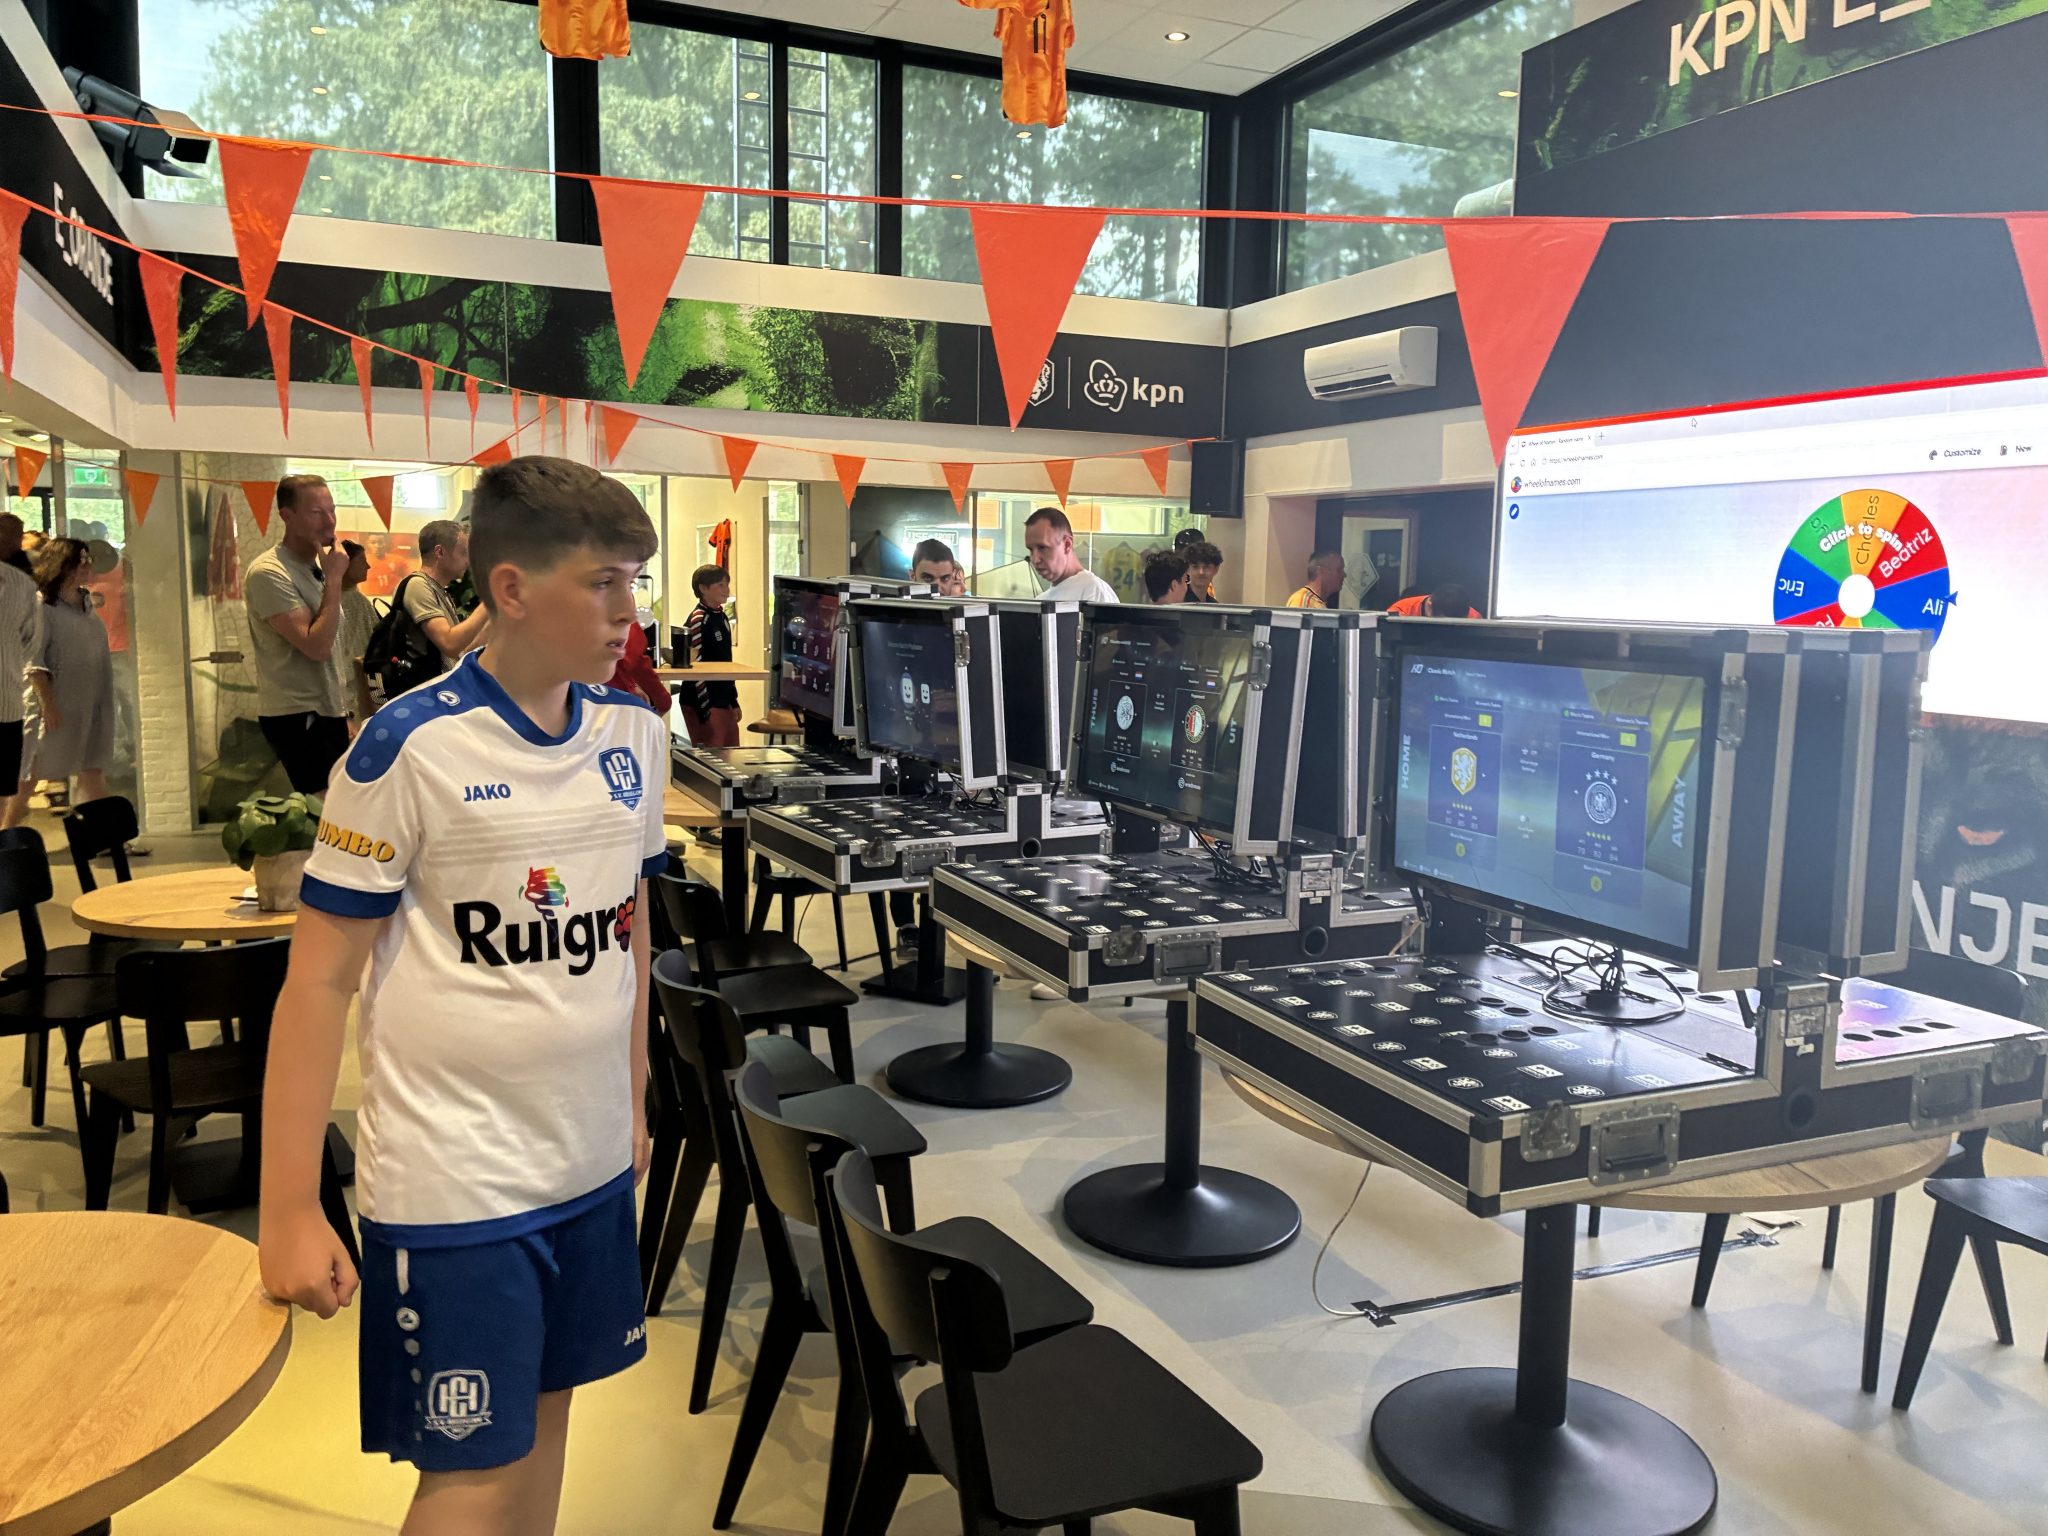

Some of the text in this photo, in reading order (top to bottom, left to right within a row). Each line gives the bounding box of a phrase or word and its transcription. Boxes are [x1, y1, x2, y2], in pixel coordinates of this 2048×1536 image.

[1669, 0, 1807, 86] KPN
[1133, 376, 1184, 408] kpn
[1943, 444, 2031, 457] Customize New
[1524, 478, 1581, 488] wheelofnames.com
[1819, 525, 1855, 552] Click
[1858, 522, 1873, 535] to
[1875, 527, 1903, 551] spin
[1878, 527, 1934, 578] Beatriz
[1778, 578, 1805, 597] Eric
[1922, 598, 1943, 616] Ali
[1401, 735, 1411, 788] HOME
[464, 783, 512, 802] JAKO
[1671, 774, 1687, 848] AWAY
[318, 818, 395, 862] UMBO
